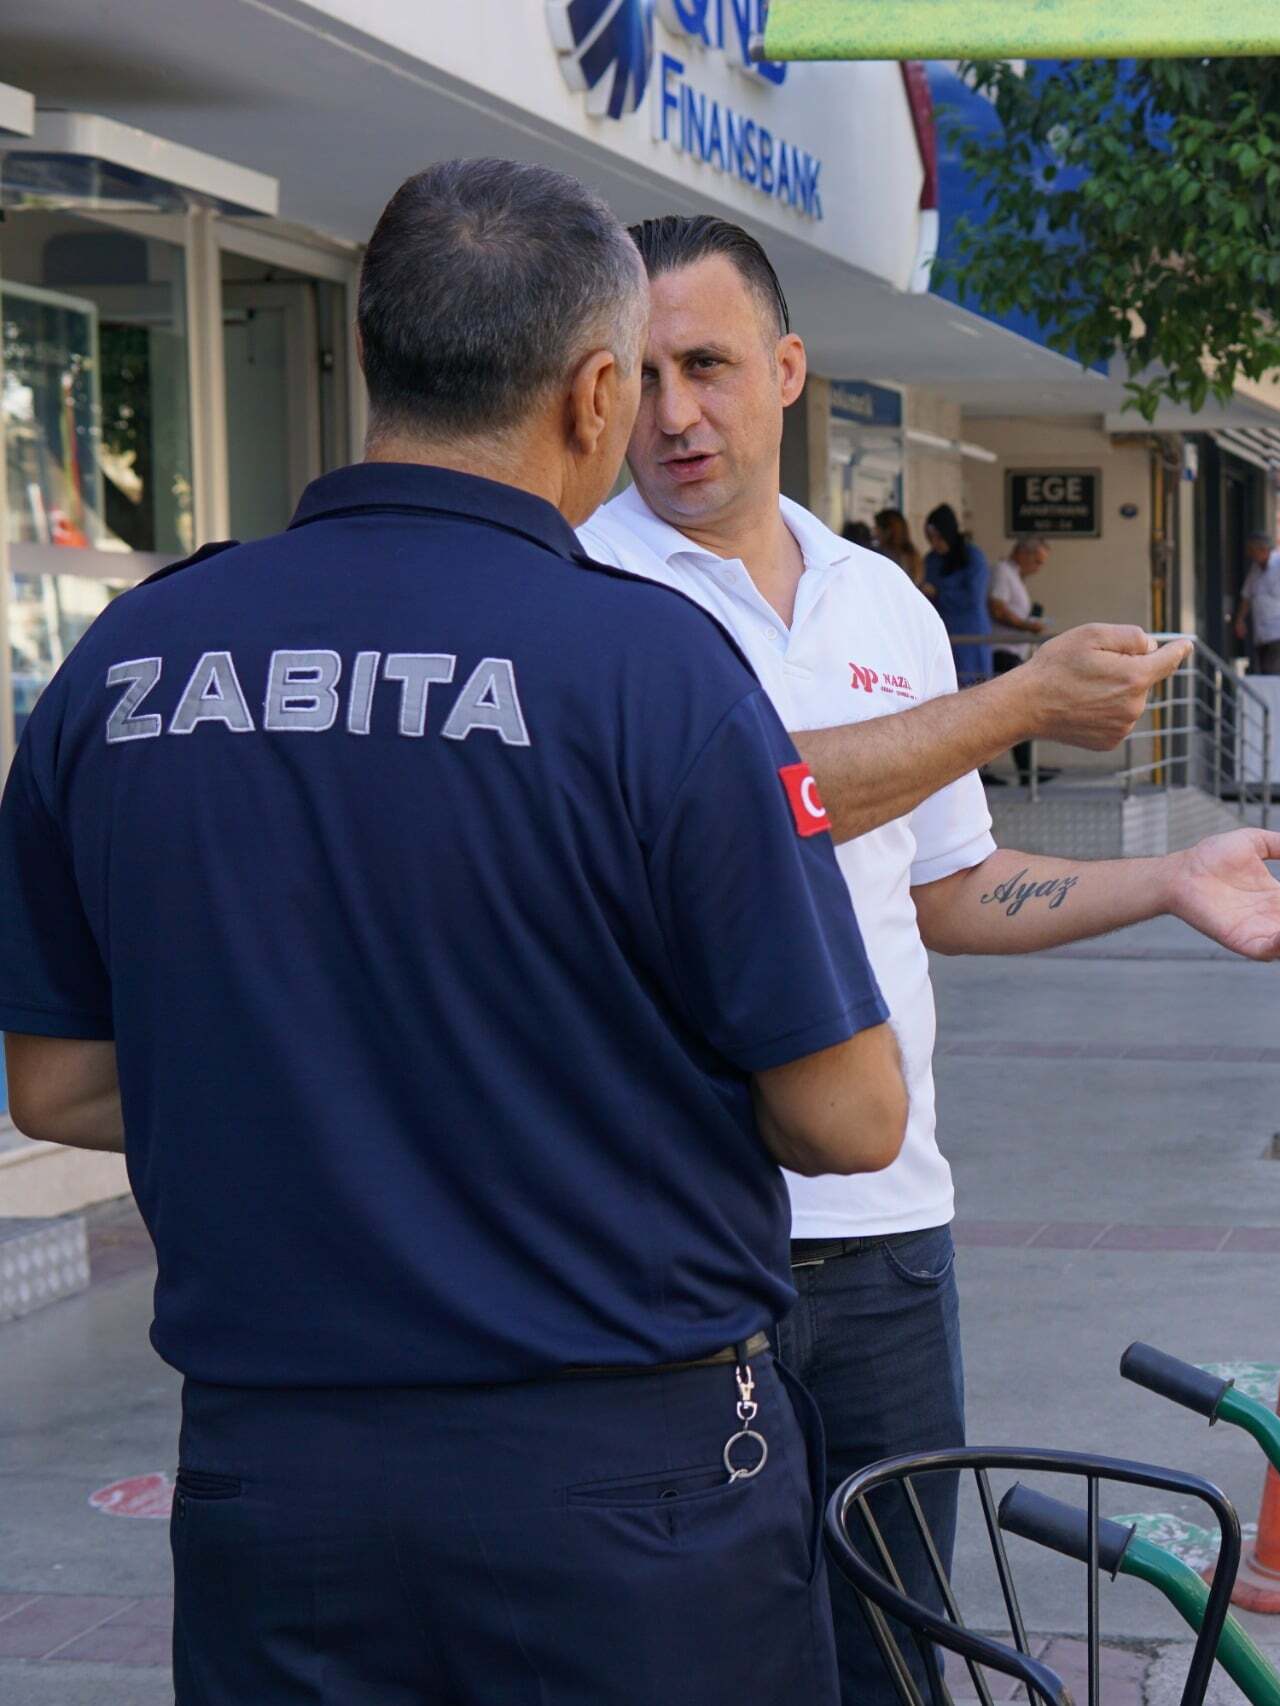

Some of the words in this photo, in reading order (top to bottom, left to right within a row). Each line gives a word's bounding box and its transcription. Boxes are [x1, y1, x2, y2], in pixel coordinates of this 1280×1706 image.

[660, 53, 823, 221] FINANSBANK
[1025, 476, 1083, 502] EGE
[104, 649, 531, 747] ZABITA
[979, 868, 1079, 917] Ayaz
